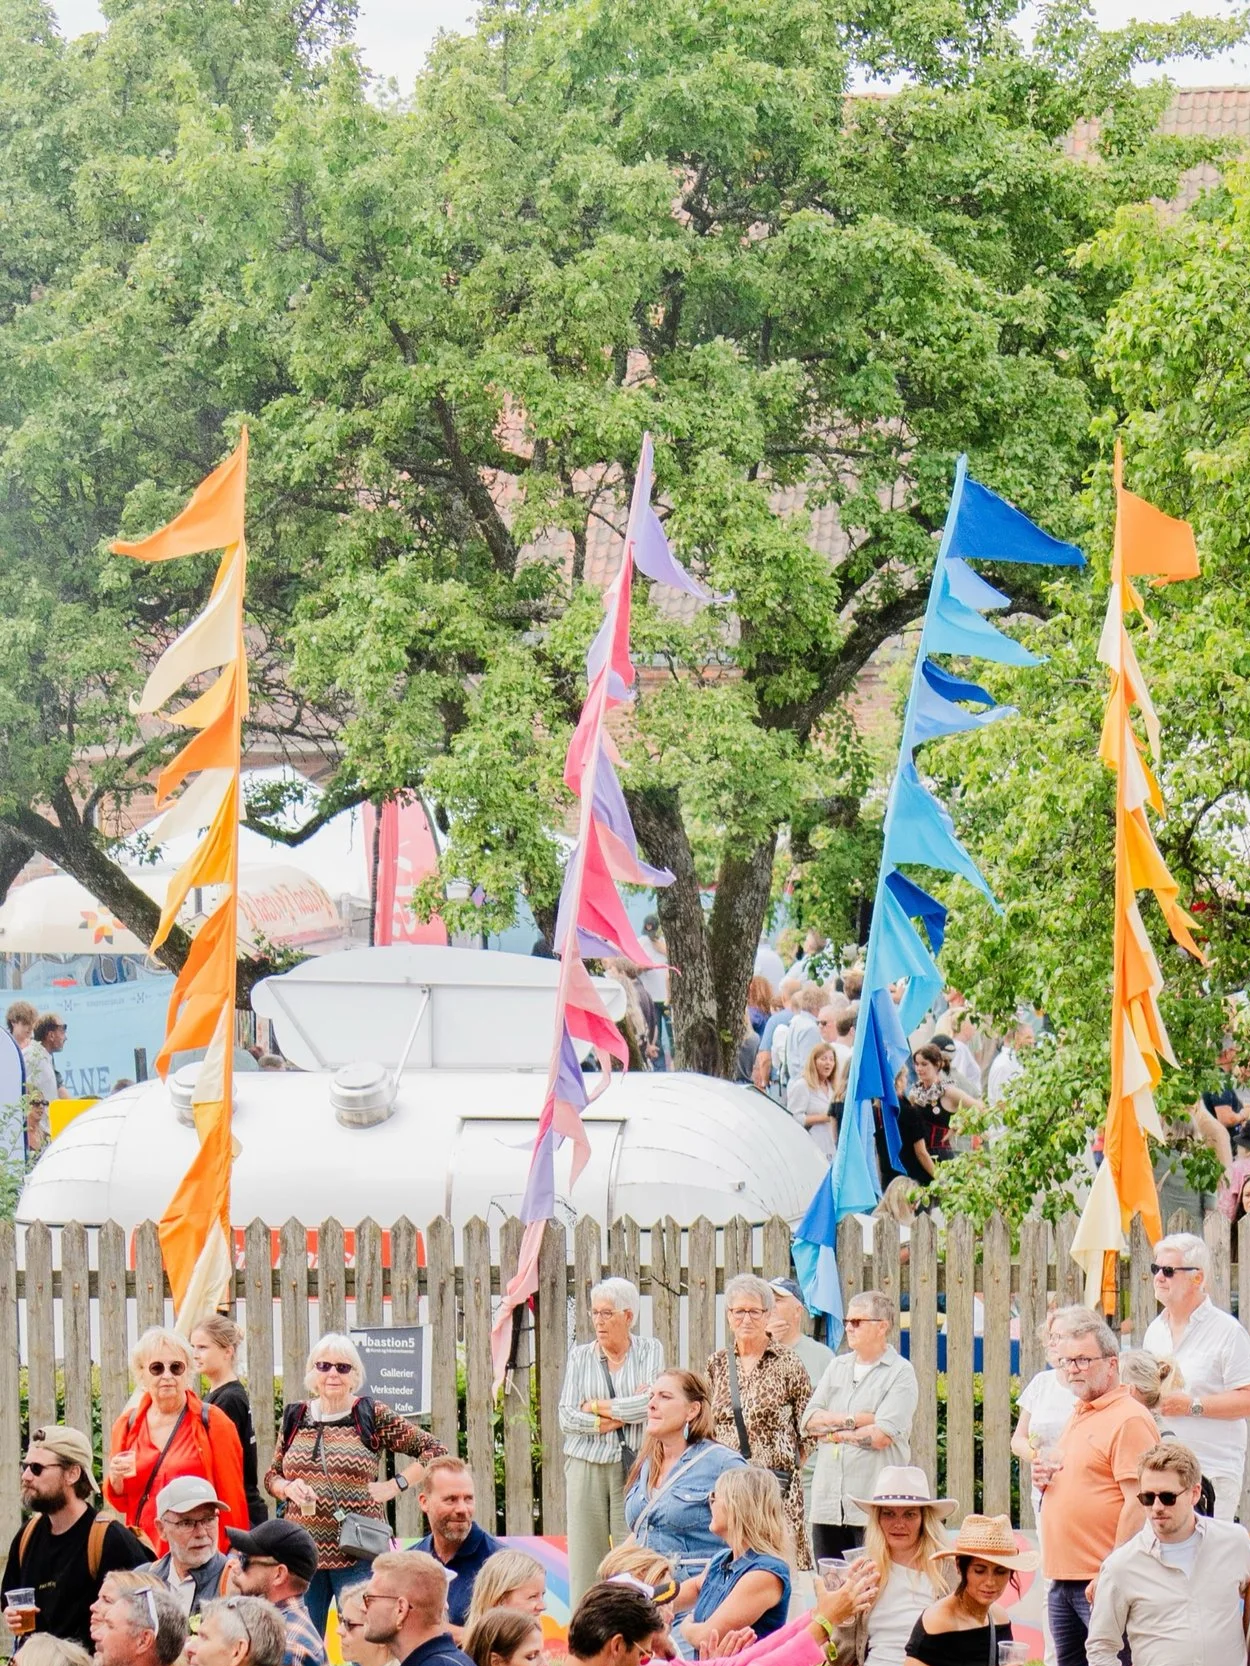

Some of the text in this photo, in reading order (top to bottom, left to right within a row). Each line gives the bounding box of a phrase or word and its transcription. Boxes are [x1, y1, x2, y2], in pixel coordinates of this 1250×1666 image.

[367, 1336, 415, 1348] bastion5
[380, 1368, 414, 1378] Gallerier
[370, 1384, 414, 1395] Verksteder
[395, 1402, 414, 1412] Kafe
